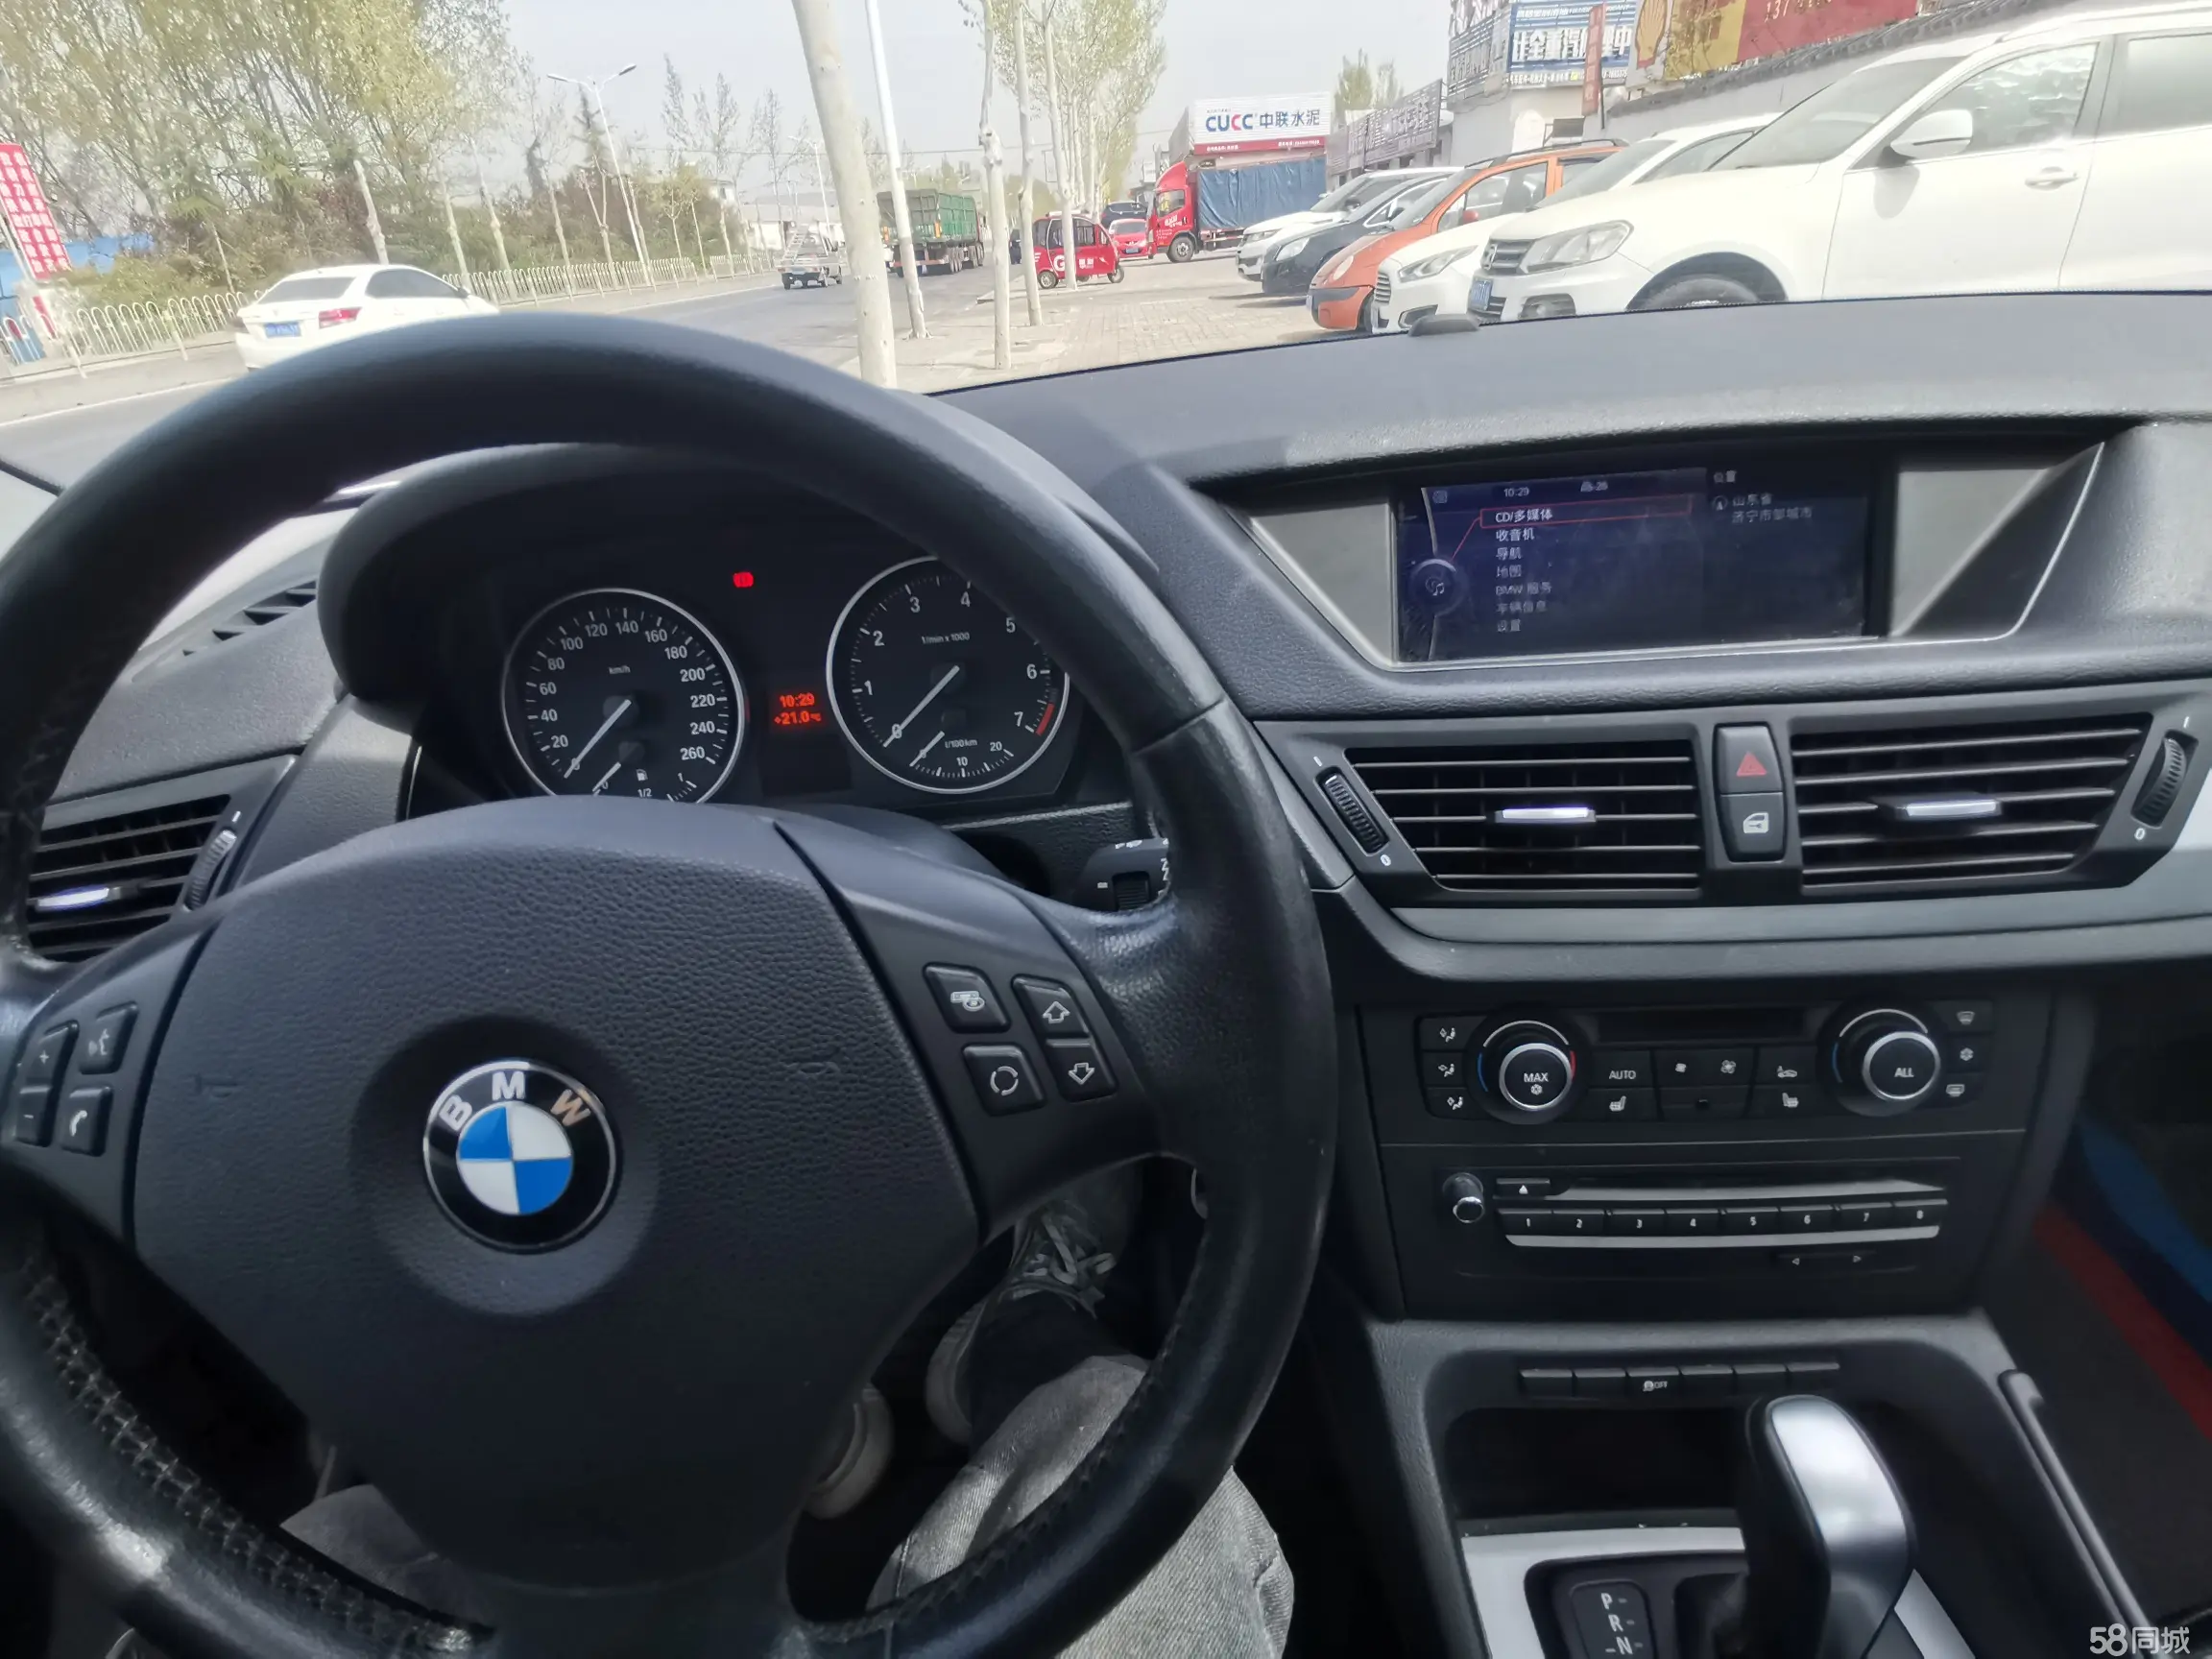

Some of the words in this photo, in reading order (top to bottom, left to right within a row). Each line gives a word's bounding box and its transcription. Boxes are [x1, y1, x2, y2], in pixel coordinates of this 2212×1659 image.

[1206, 113, 1254, 132] CUCC
[1259, 108, 1320, 129] 中联水泥
[1495, 508, 1553, 523] CD/多媒体
[1496, 527, 1535, 542] 收音机
[910, 596, 921, 613] 3
[960, 591, 971, 607] 4
[584, 622, 608, 637] 120
[615, 620, 639, 635] 140
[1005, 616, 1016, 633] 5
[560, 637, 584, 650] 100
[644, 629, 668, 643] 160
[873, 630, 885, 646] 2
[664, 645, 688, 660] 180
[547, 657, 565, 671] 80
[1026, 663, 1038, 680] 6
[680, 667, 706, 683] 200
[539, 681, 558, 696] 60
[864, 680, 874, 695] 1
[689, 693, 716, 709] 220
[779, 692, 815, 709] 10:29
[541, 709, 559, 722] 40
[1014, 711, 1024, 727] 7
[689, 721, 716, 735] 240
[550, 734, 569, 749] 20
[990, 741, 1003, 752] 20
[680, 746, 706, 761] 260
[956, 757, 969, 767] 10
[1523, 1071, 1550, 1083] MAX
[1608, 1070, 1637, 1080] AUTO
[1893, 1067, 1915, 1078] ALL
[1600, 1592, 1613, 1610] P
[1607, 1614, 1624, 1632] R
[1616, 1636, 1634, 1655] N
